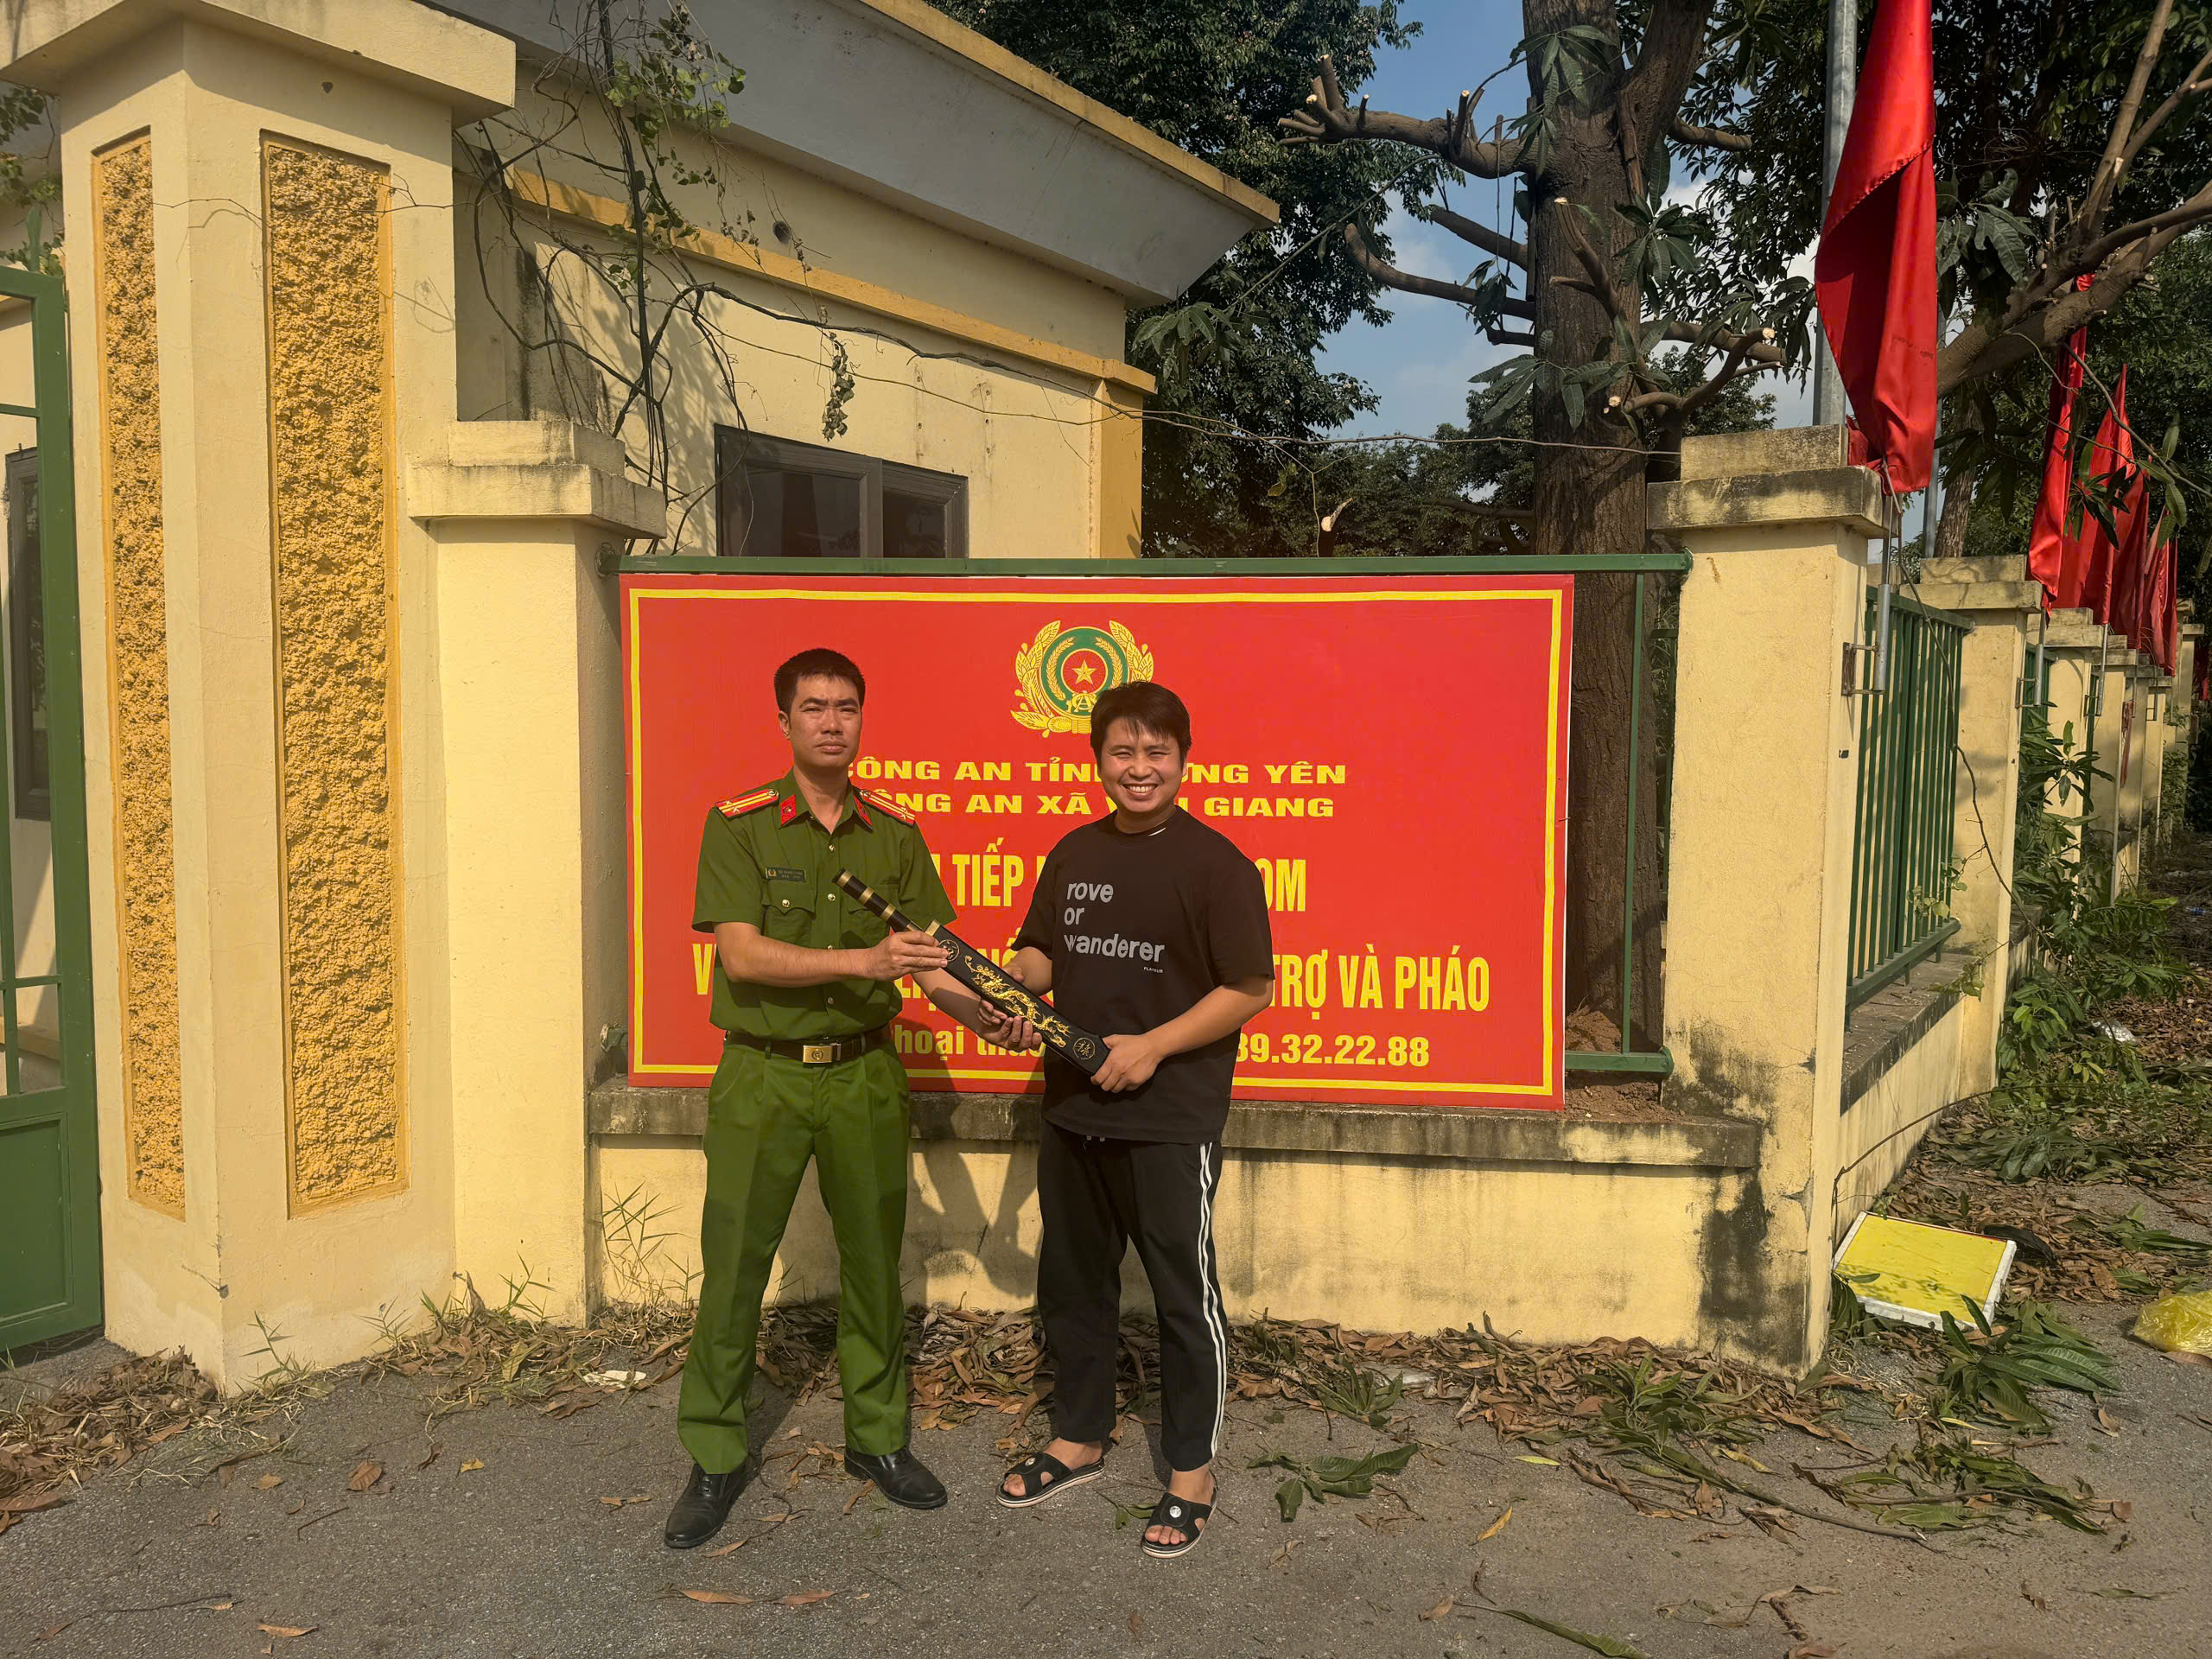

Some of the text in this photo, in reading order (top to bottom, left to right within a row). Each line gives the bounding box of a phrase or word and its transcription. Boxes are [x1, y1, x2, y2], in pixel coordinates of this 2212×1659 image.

[848, 756, 940, 779] ÔNG
[954, 761, 1011, 781] AN
[1264, 760, 1345, 784] YÊN
[965, 794, 1022, 813] AN
[1037, 792, 1092, 815] XÃ
[1205, 797, 1334, 817] GIANG
[952, 837, 1024, 906] TIẾP
[1066, 882, 1114, 903] rove
[1064, 907, 1085, 925] or
[1064, 933, 1165, 963] wanderer
[1338, 944, 1383, 1008] VÀ
[1395, 945, 1490, 1012] PHÁO
